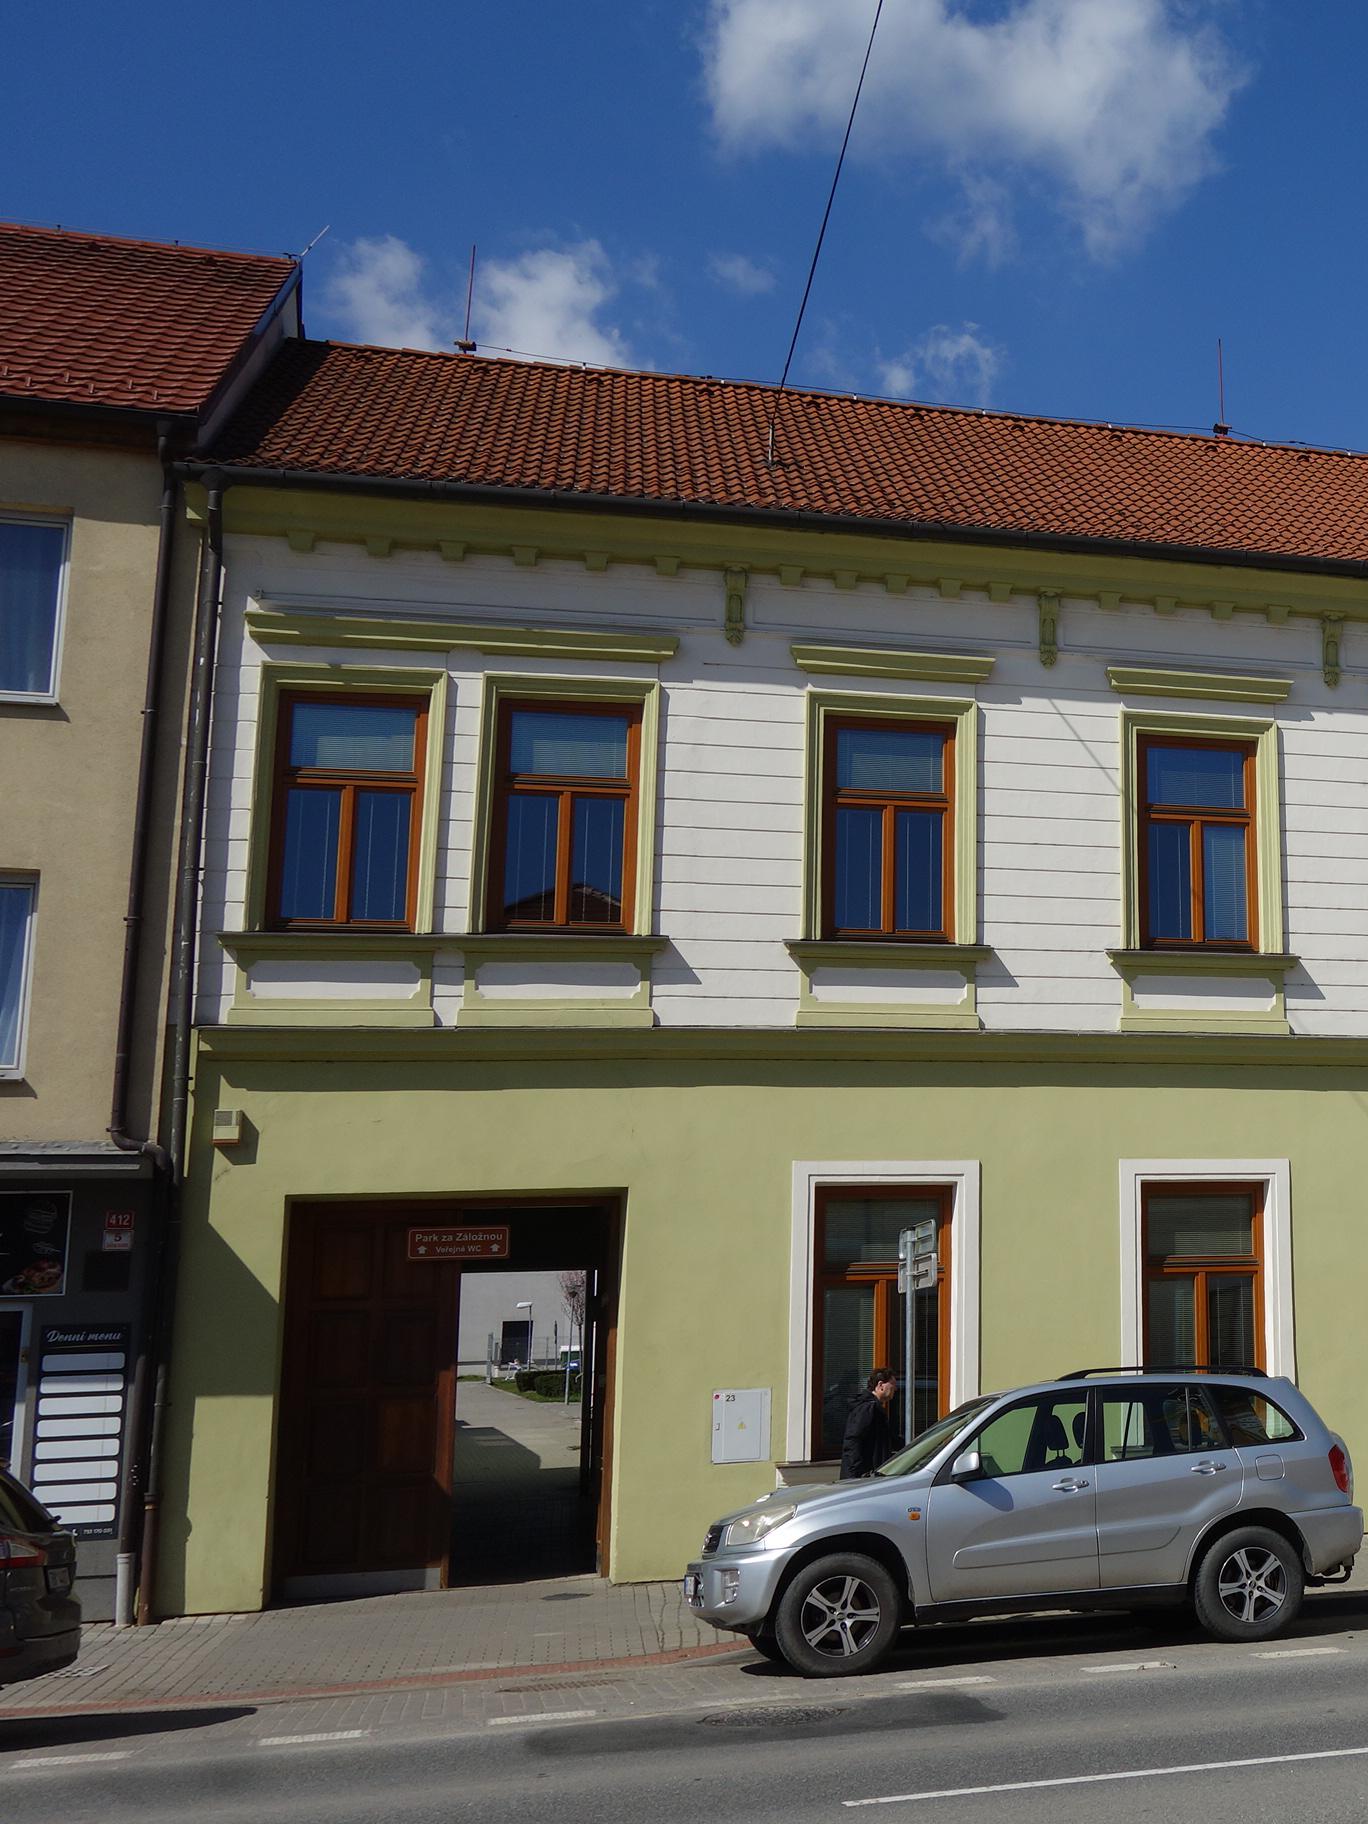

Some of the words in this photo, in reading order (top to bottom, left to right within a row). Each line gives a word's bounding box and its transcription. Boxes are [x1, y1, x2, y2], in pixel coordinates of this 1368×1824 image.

[109, 1213, 130, 1225] 412
[113, 1233, 122, 1242] 5
[415, 1233, 439, 1242] Park
[455, 1232, 503, 1241] Záložnou
[87, 1332, 121, 1341] menu
[725, 1394, 736, 1402] 23
